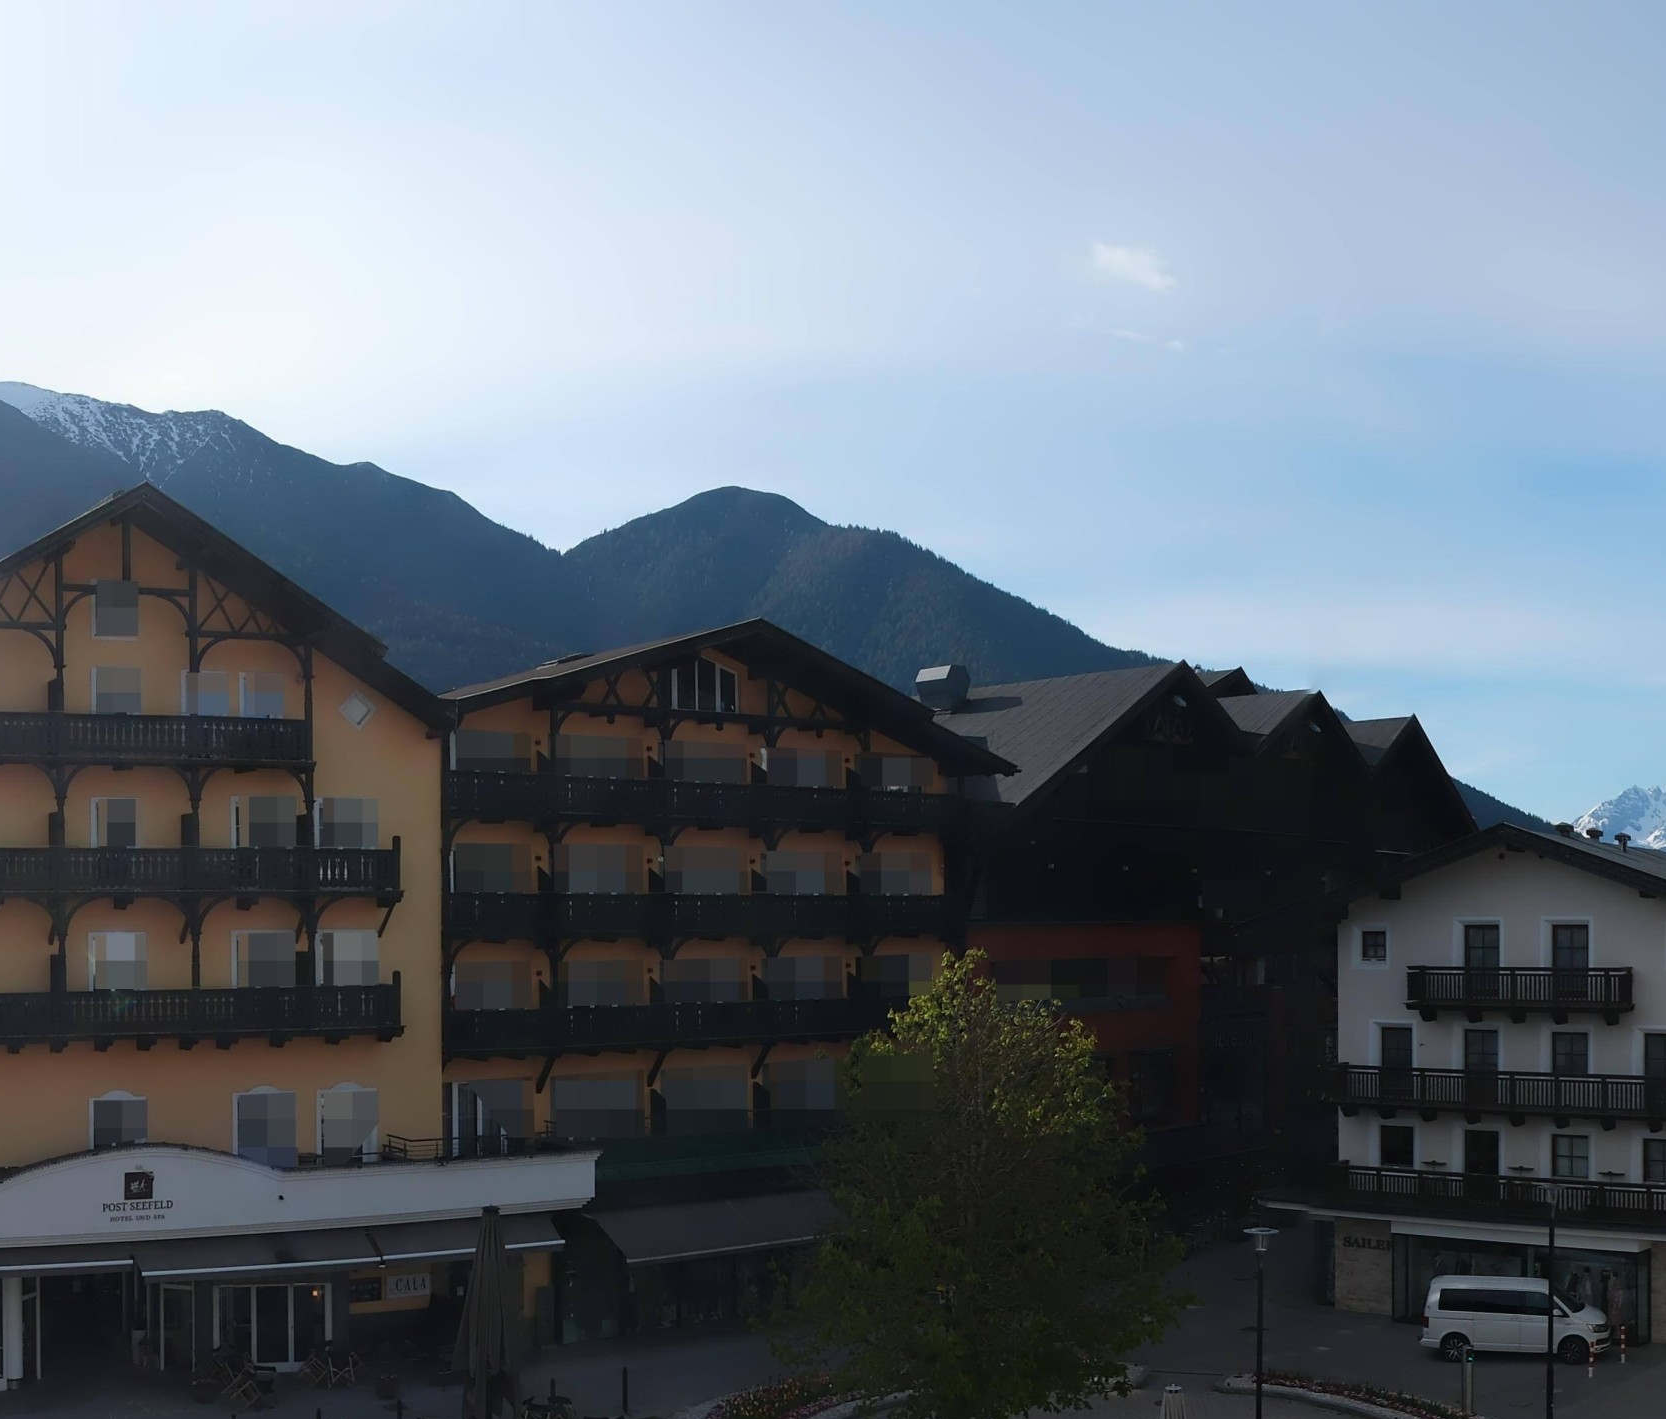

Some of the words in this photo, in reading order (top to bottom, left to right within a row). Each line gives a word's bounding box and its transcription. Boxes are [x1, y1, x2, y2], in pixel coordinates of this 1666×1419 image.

[102, 1202, 127, 1212] POST
[129, 1200, 174, 1211] SEEFELD
[395, 1276, 426, 1292] CALA
